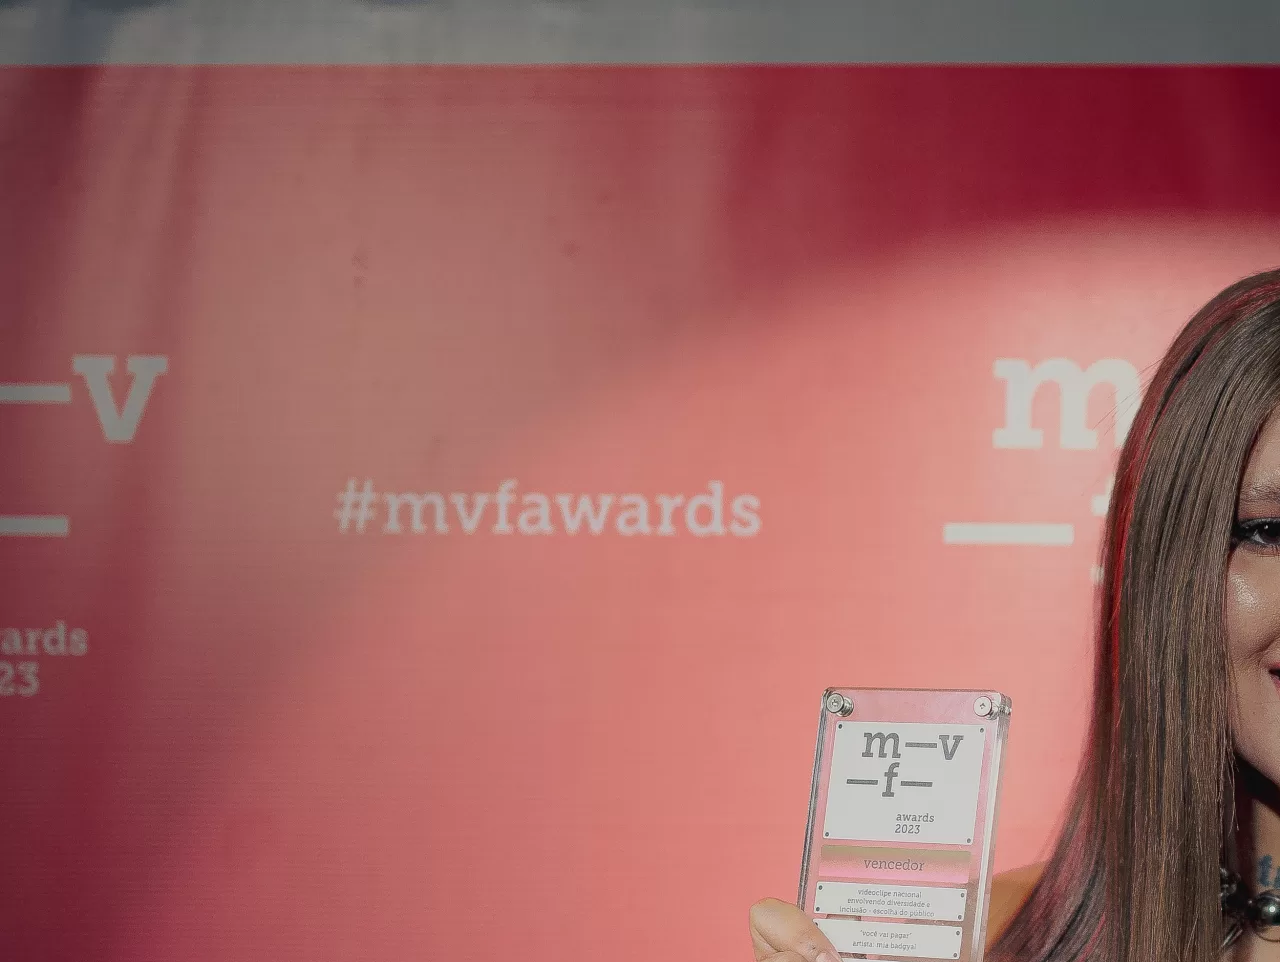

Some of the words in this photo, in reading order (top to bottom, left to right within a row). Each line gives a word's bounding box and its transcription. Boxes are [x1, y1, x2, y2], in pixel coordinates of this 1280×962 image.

[334, 479, 763, 537] #mvfawards
[895, 813, 935, 823] awards
[894, 824, 921, 834] 2023
[863, 859, 926, 871] vencedor
[857, 889, 892, 898] videoclipe
[892, 890, 922, 898] nacional
[847, 898, 886, 906] envolvendo
[886, 899, 926, 908] diversidade
[839, 905, 868, 914] inclusão
[872, 907, 898, 916] escolha
[899, 908, 908, 916] do
[909, 909, 935, 918] público
